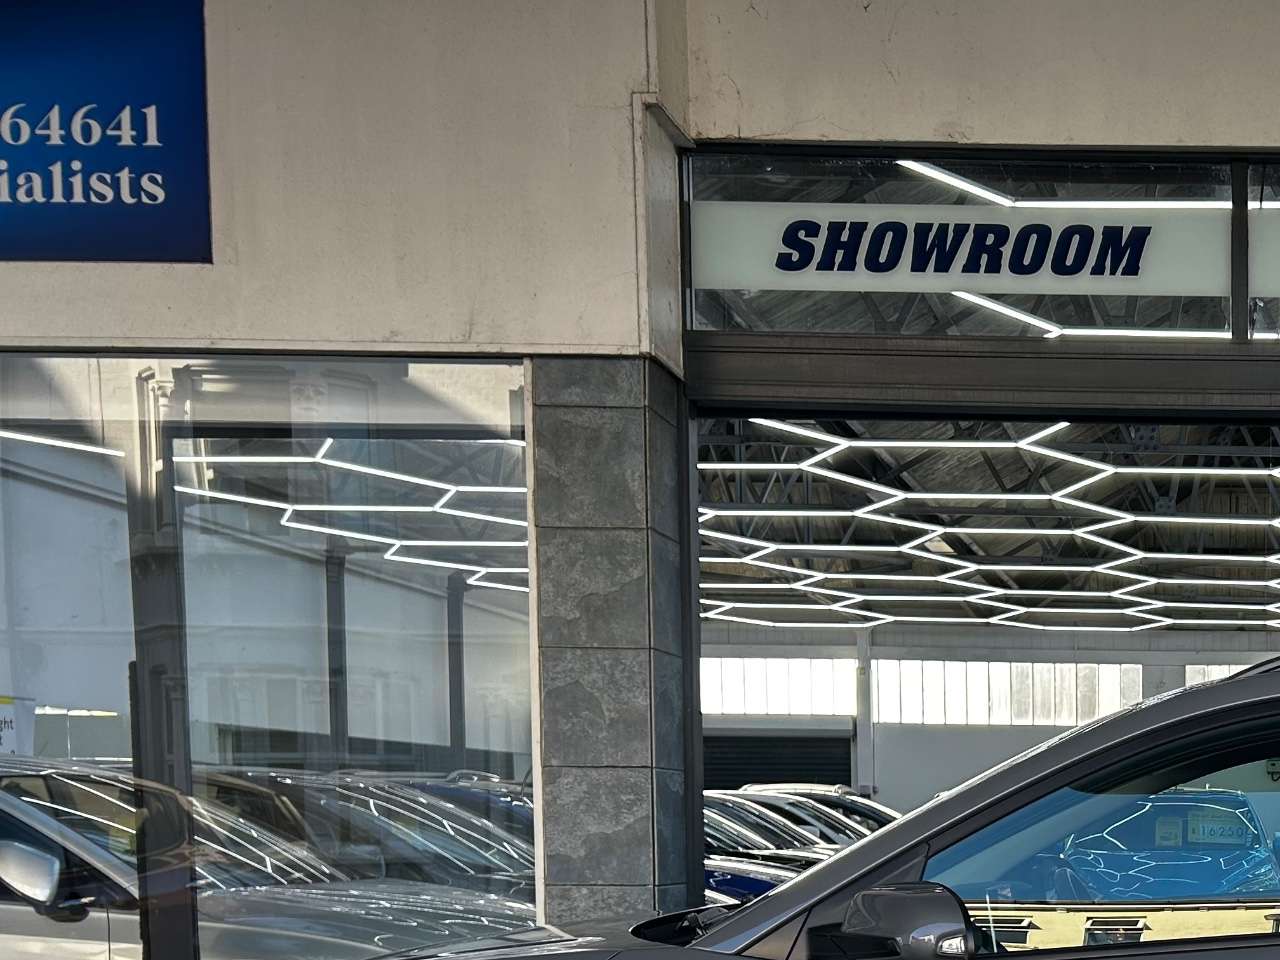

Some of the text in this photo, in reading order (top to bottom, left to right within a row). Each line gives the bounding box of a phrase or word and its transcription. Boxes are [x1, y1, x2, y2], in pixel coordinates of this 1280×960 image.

[0, 103, 163, 147] 64641
[0, 159, 166, 205] ialists
[775, 219, 1152, 277] SHOWROOM
